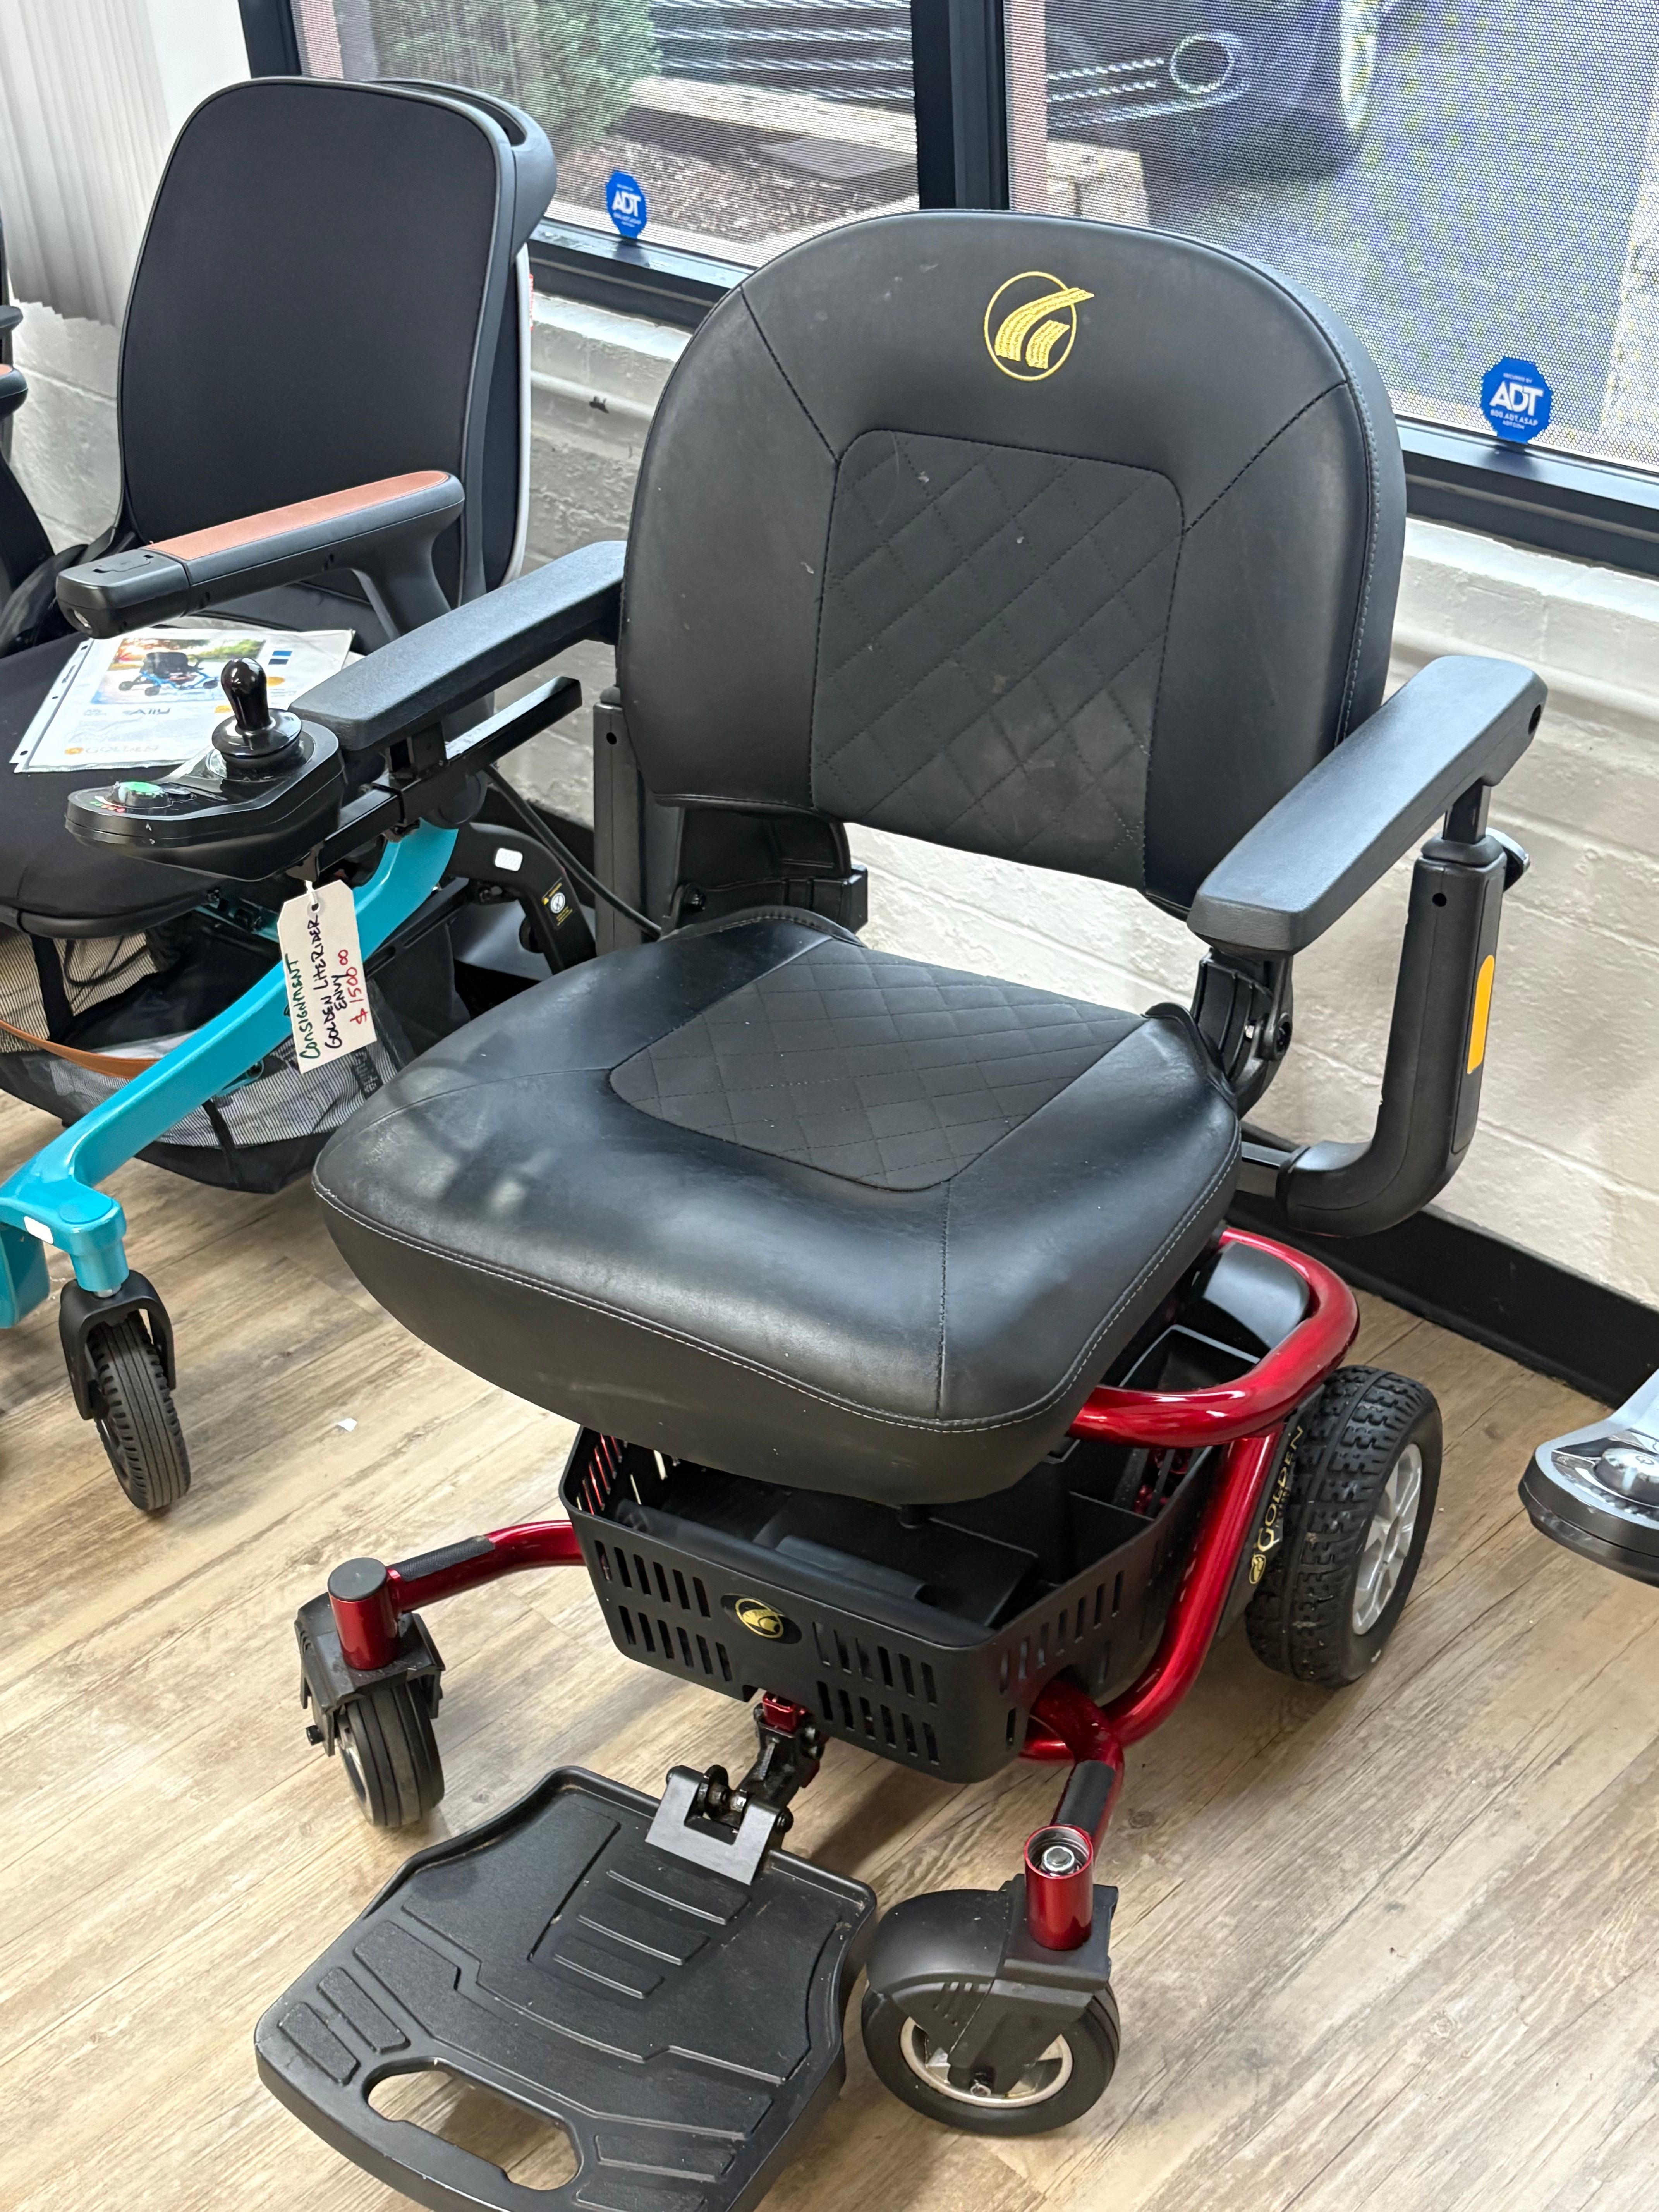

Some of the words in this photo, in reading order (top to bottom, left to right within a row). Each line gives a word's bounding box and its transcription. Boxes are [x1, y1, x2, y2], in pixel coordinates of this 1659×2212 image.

[611, 190, 641, 217] ADT
[1489, 381, 1544, 416] ADT
[307, 914, 328, 990] LITERIDER
[285, 953, 321, 1059] CONSIGNMENT
[331, 974, 349, 1011] ENVY
[321, 996, 342, 1049] GOLDEN
[1257, 1426, 1303, 1552] GOLDEN
